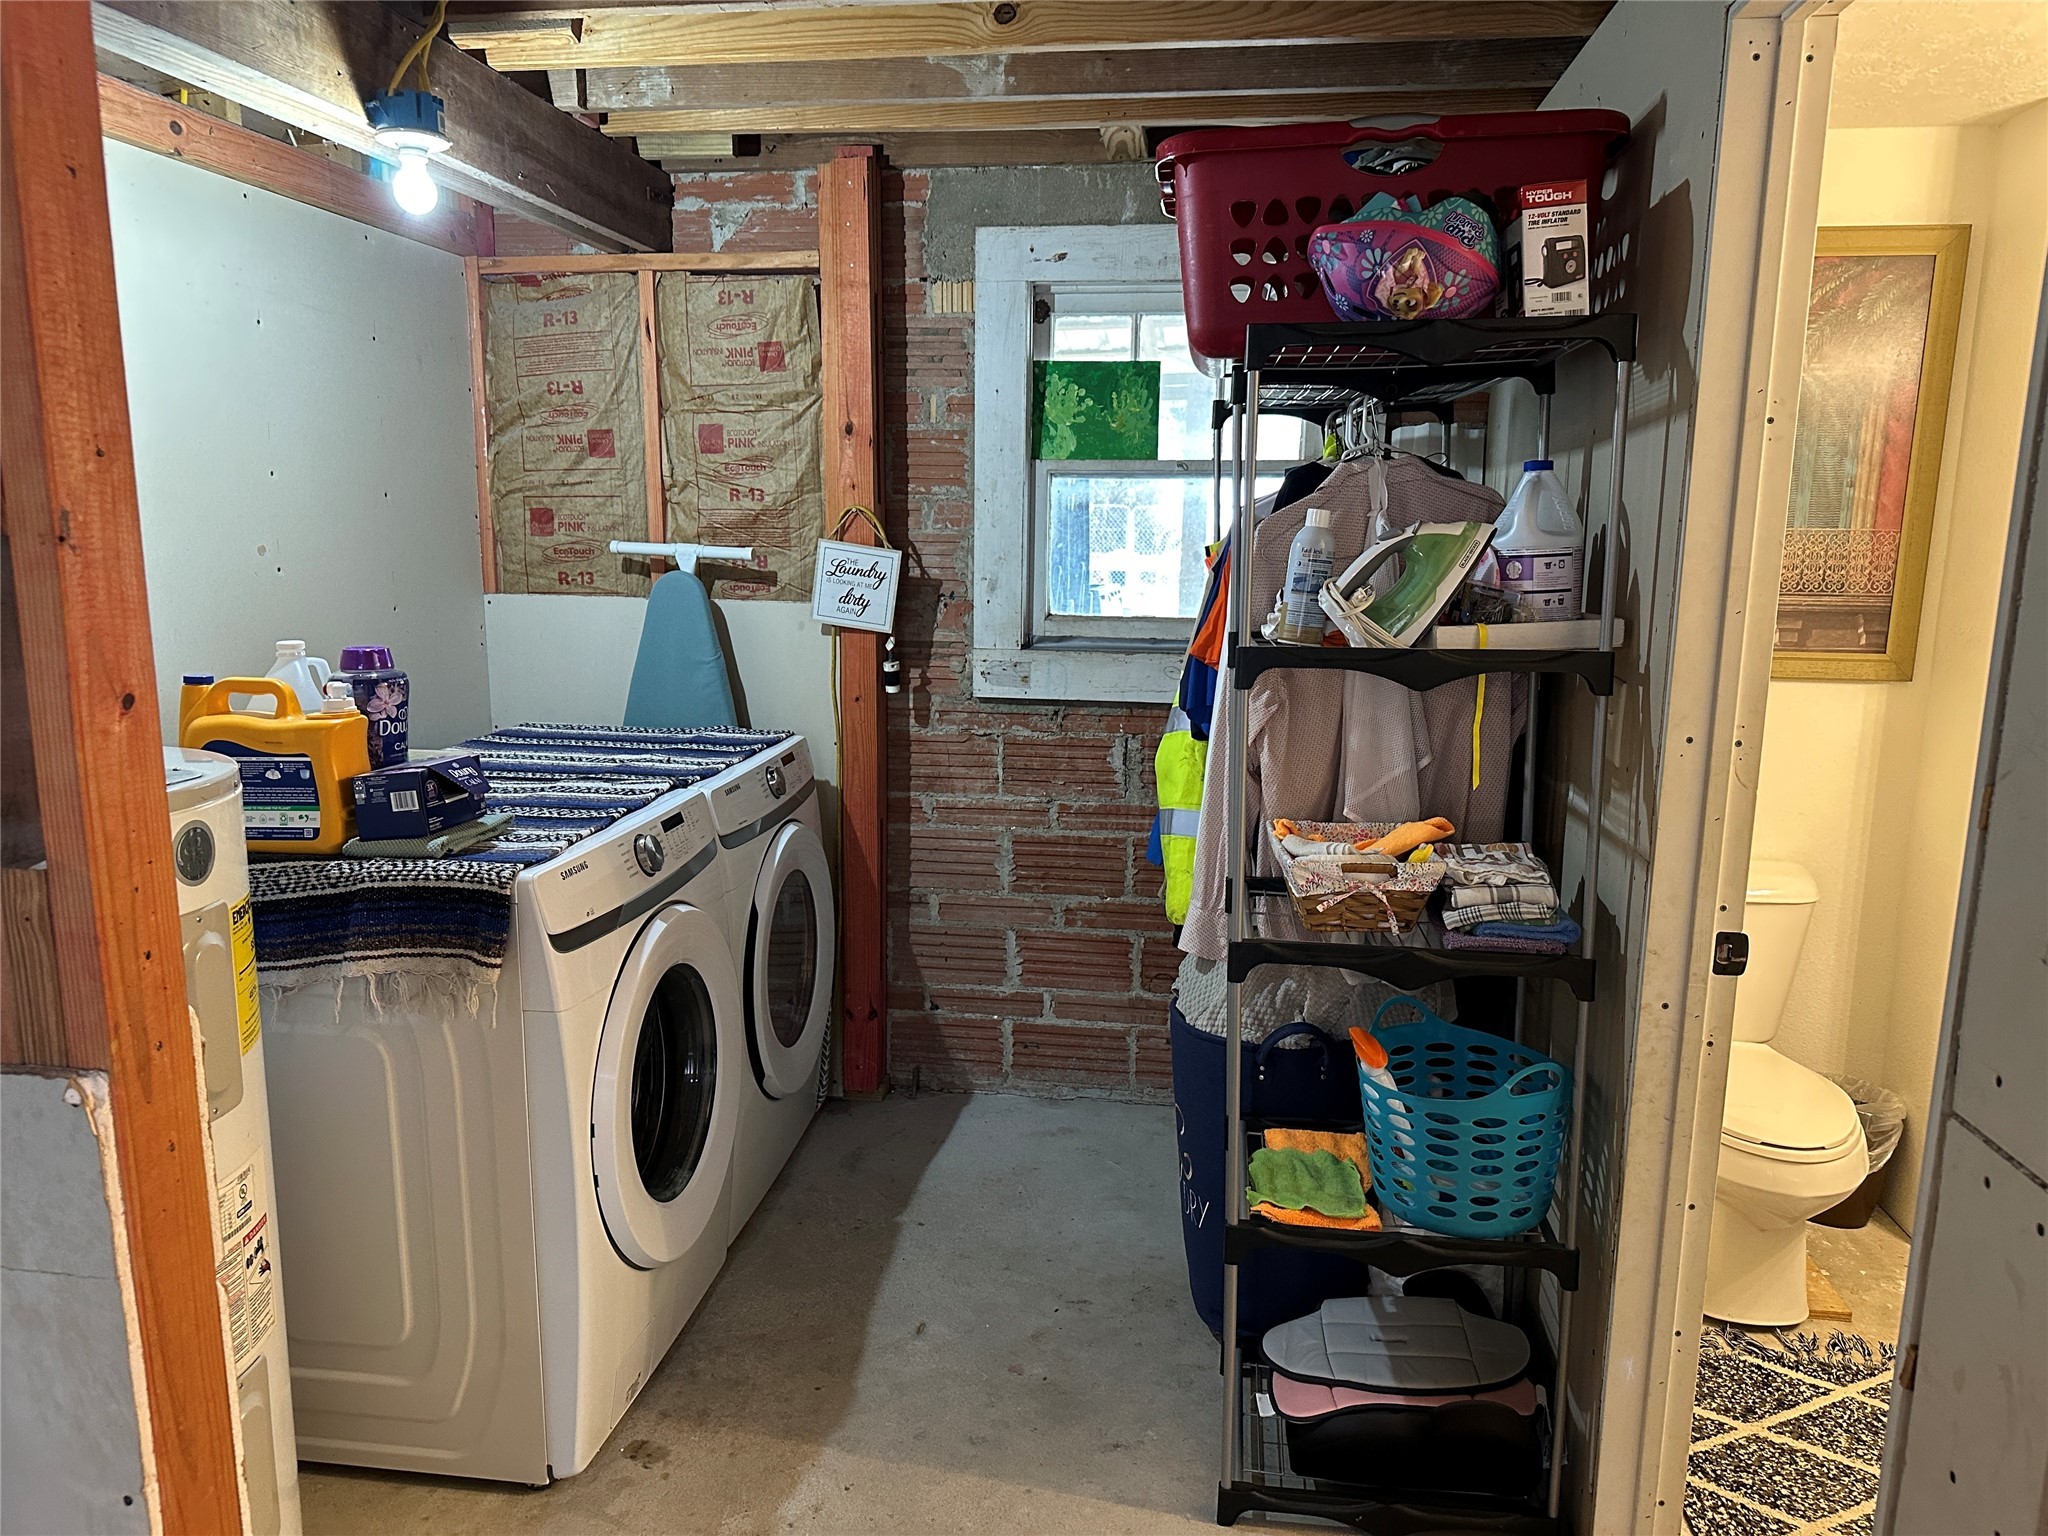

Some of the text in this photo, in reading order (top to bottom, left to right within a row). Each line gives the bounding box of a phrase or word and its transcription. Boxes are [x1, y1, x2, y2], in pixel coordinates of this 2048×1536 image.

[1526, 188, 1553, 197] HYPER
[1526, 191, 1572, 203] TOUGH
[1528, 208, 1581, 220] 12-VOLT STANDARD
[1527, 217, 1568, 226] TIRE INFLATOR
[718, 289, 754, 305] R-13
[543, 310, 578, 327] R-13
[716, 321, 757, 331] EcoTouch
[692, 347, 753, 359] PINK INSULATION
[546, 380, 584, 395] R-13
[548, 410, 589, 420] EcoTouch
[556, 434, 583, 445] PINK
[727, 438, 755, 449] PINK
[724, 463, 767, 472] EcoTouch
[729, 487, 765, 502] R-13
[558, 522, 585, 532] PINK
[553, 547, 595, 555] EcoTouch
[846, 557, 858, 567] THE
[557, 571, 594, 585] R-13
[825, 558, 887, 590] Laundry
[832, 578, 856, 587] LOOKING
[730, 584, 771, 593] EcoTouch
[838, 587, 871, 617] dirty
[836, 605, 857, 615] AGAIN
[448, 766, 478, 779] Downy
[464, 777, 483, 787] CALM
[724, 782, 741, 796] SAMSUNG
[560, 860, 589, 881] SAMSUNG
